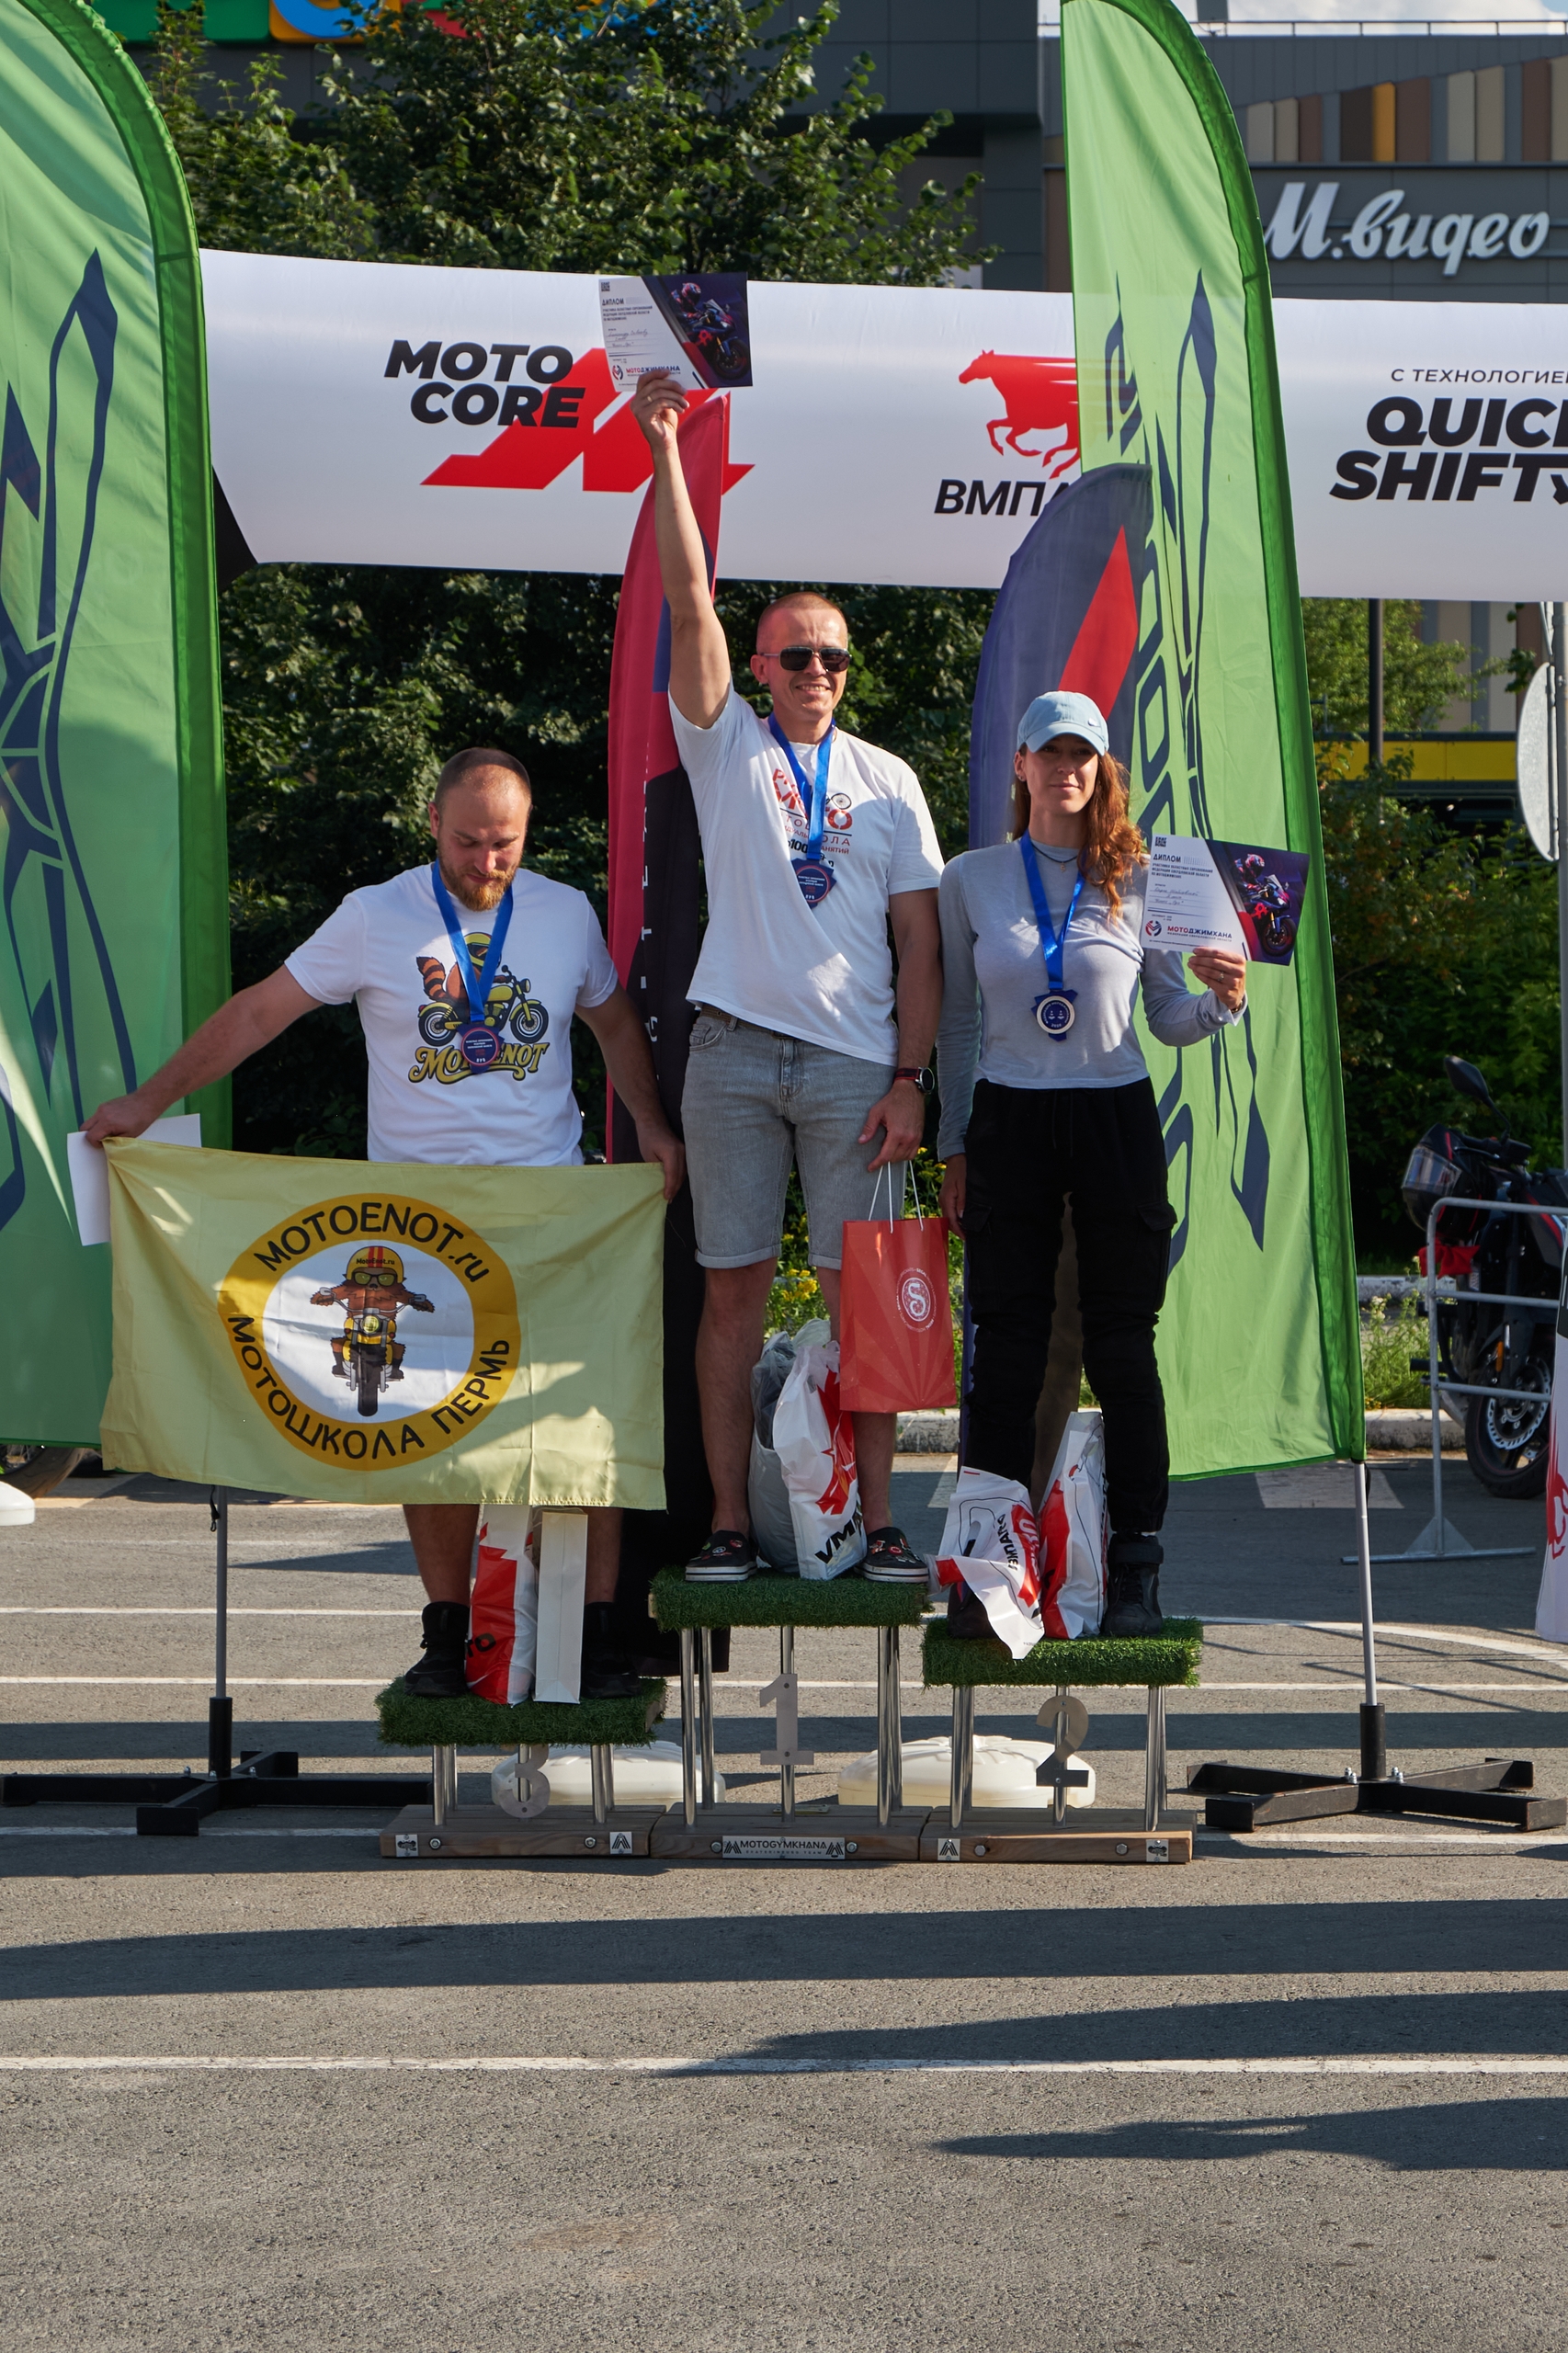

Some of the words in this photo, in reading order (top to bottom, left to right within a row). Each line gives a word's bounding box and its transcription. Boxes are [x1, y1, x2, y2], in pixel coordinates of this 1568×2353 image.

[1264, 182, 1551, 277] М.видео
[384, 339, 574, 384] MOTO
[1413, 369, 1568, 384] ТЕХНОЛОГИЕ
[410, 381, 586, 428] CORE
[1153, 853, 1181, 863] ДИПЛОМ
[1167, 926, 1233, 939] МОТОДЖИМХАНА
[254, 1202, 490, 1282] MOTOENOT.ru
[356, 1257, 395, 1266] MotoEnot.ru
[228, 1316, 425, 1460] МОТОШКОЛА
[431, 1339, 510, 1435] ПЕРМЬ
[759, 1674, 814, 1766] 1
[1036, 1694, 1089, 1787] 2
[740, 1840, 826, 1849] MOTOGYMKHANA
